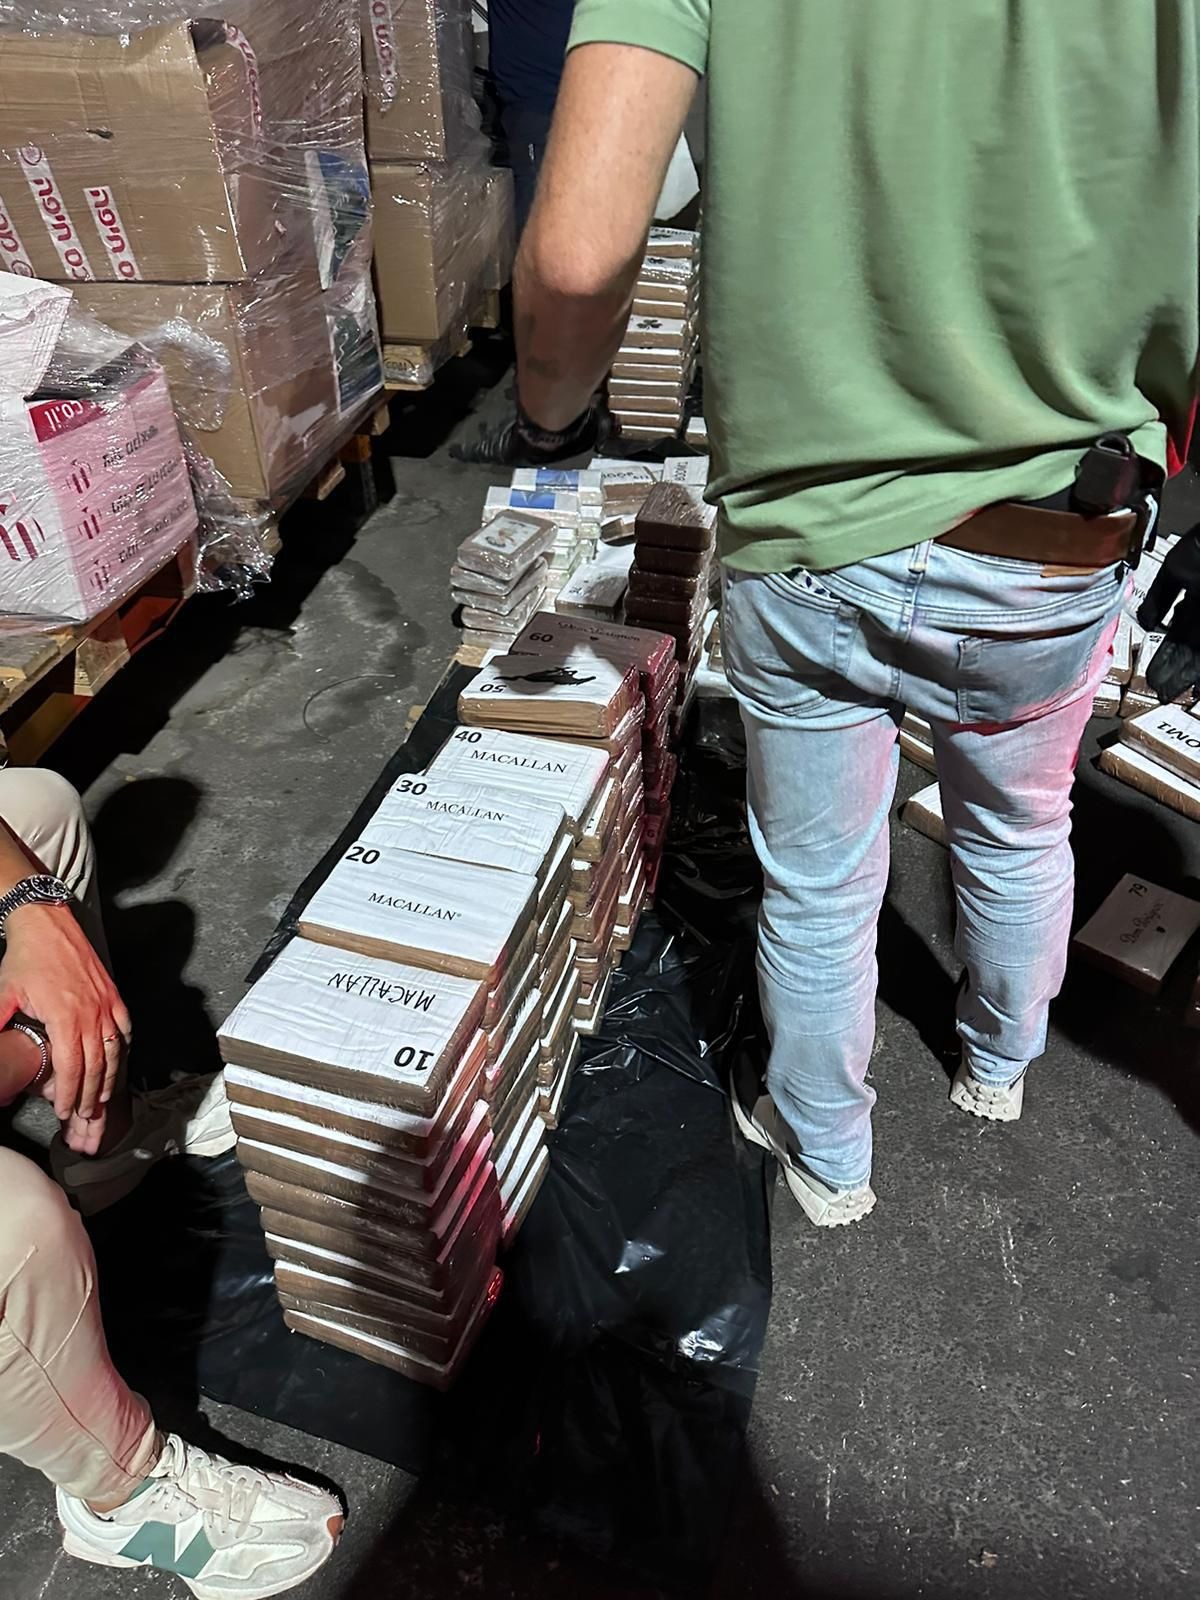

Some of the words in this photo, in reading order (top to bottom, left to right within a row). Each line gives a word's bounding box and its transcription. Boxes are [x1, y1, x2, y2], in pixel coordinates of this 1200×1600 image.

[33, 177, 72, 241] חיפה
[89, 189, 125, 253] חיפה
[529, 632, 554, 643] 60
[454, 730, 482, 744] 40
[470, 749, 568, 773] MACALLAN
[396, 779, 428, 796] 30
[345, 846, 381, 865] 20
[1128, 882, 1148, 898] 79
[327, 972, 436, 1012] MACALLAN
[394, 1046, 434, 1072] 10
